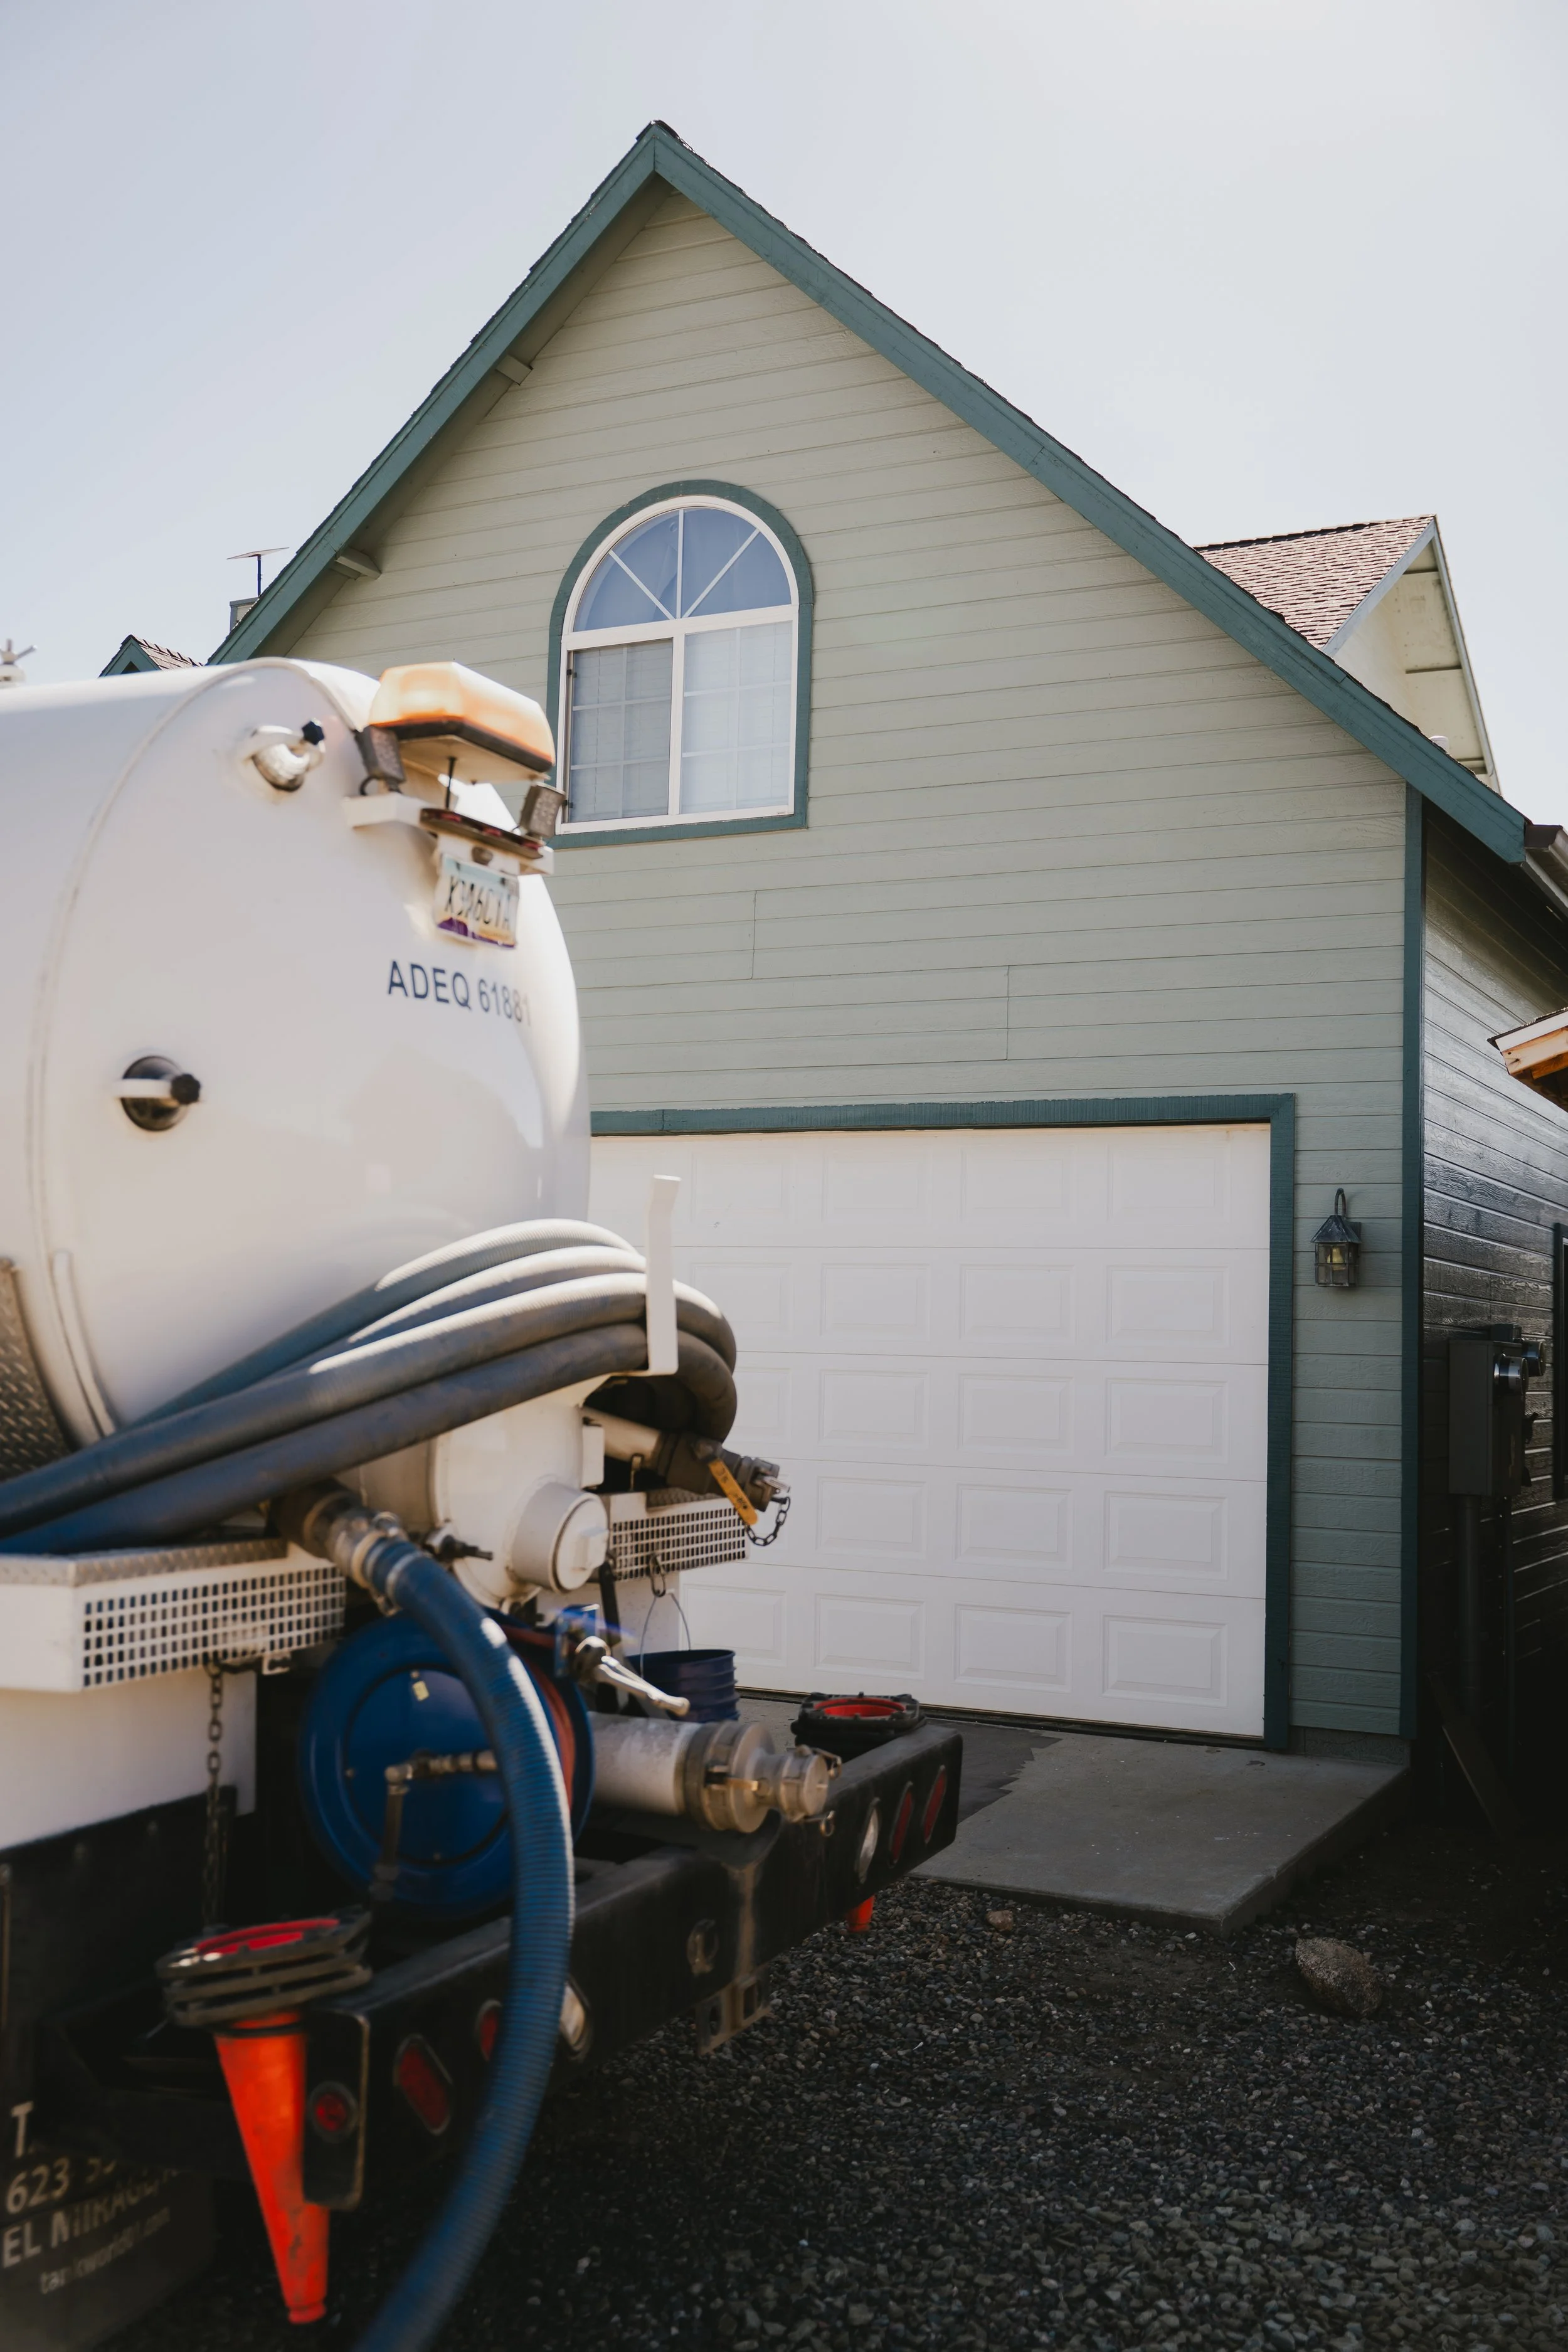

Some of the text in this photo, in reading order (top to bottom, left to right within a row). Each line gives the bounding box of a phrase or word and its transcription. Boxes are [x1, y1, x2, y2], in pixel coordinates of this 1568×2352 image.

[388, 960, 531, 1027] ADEQ 61881
[6, 2156, 71, 2215] 623
[3, 2221, 41, 2268] EL
